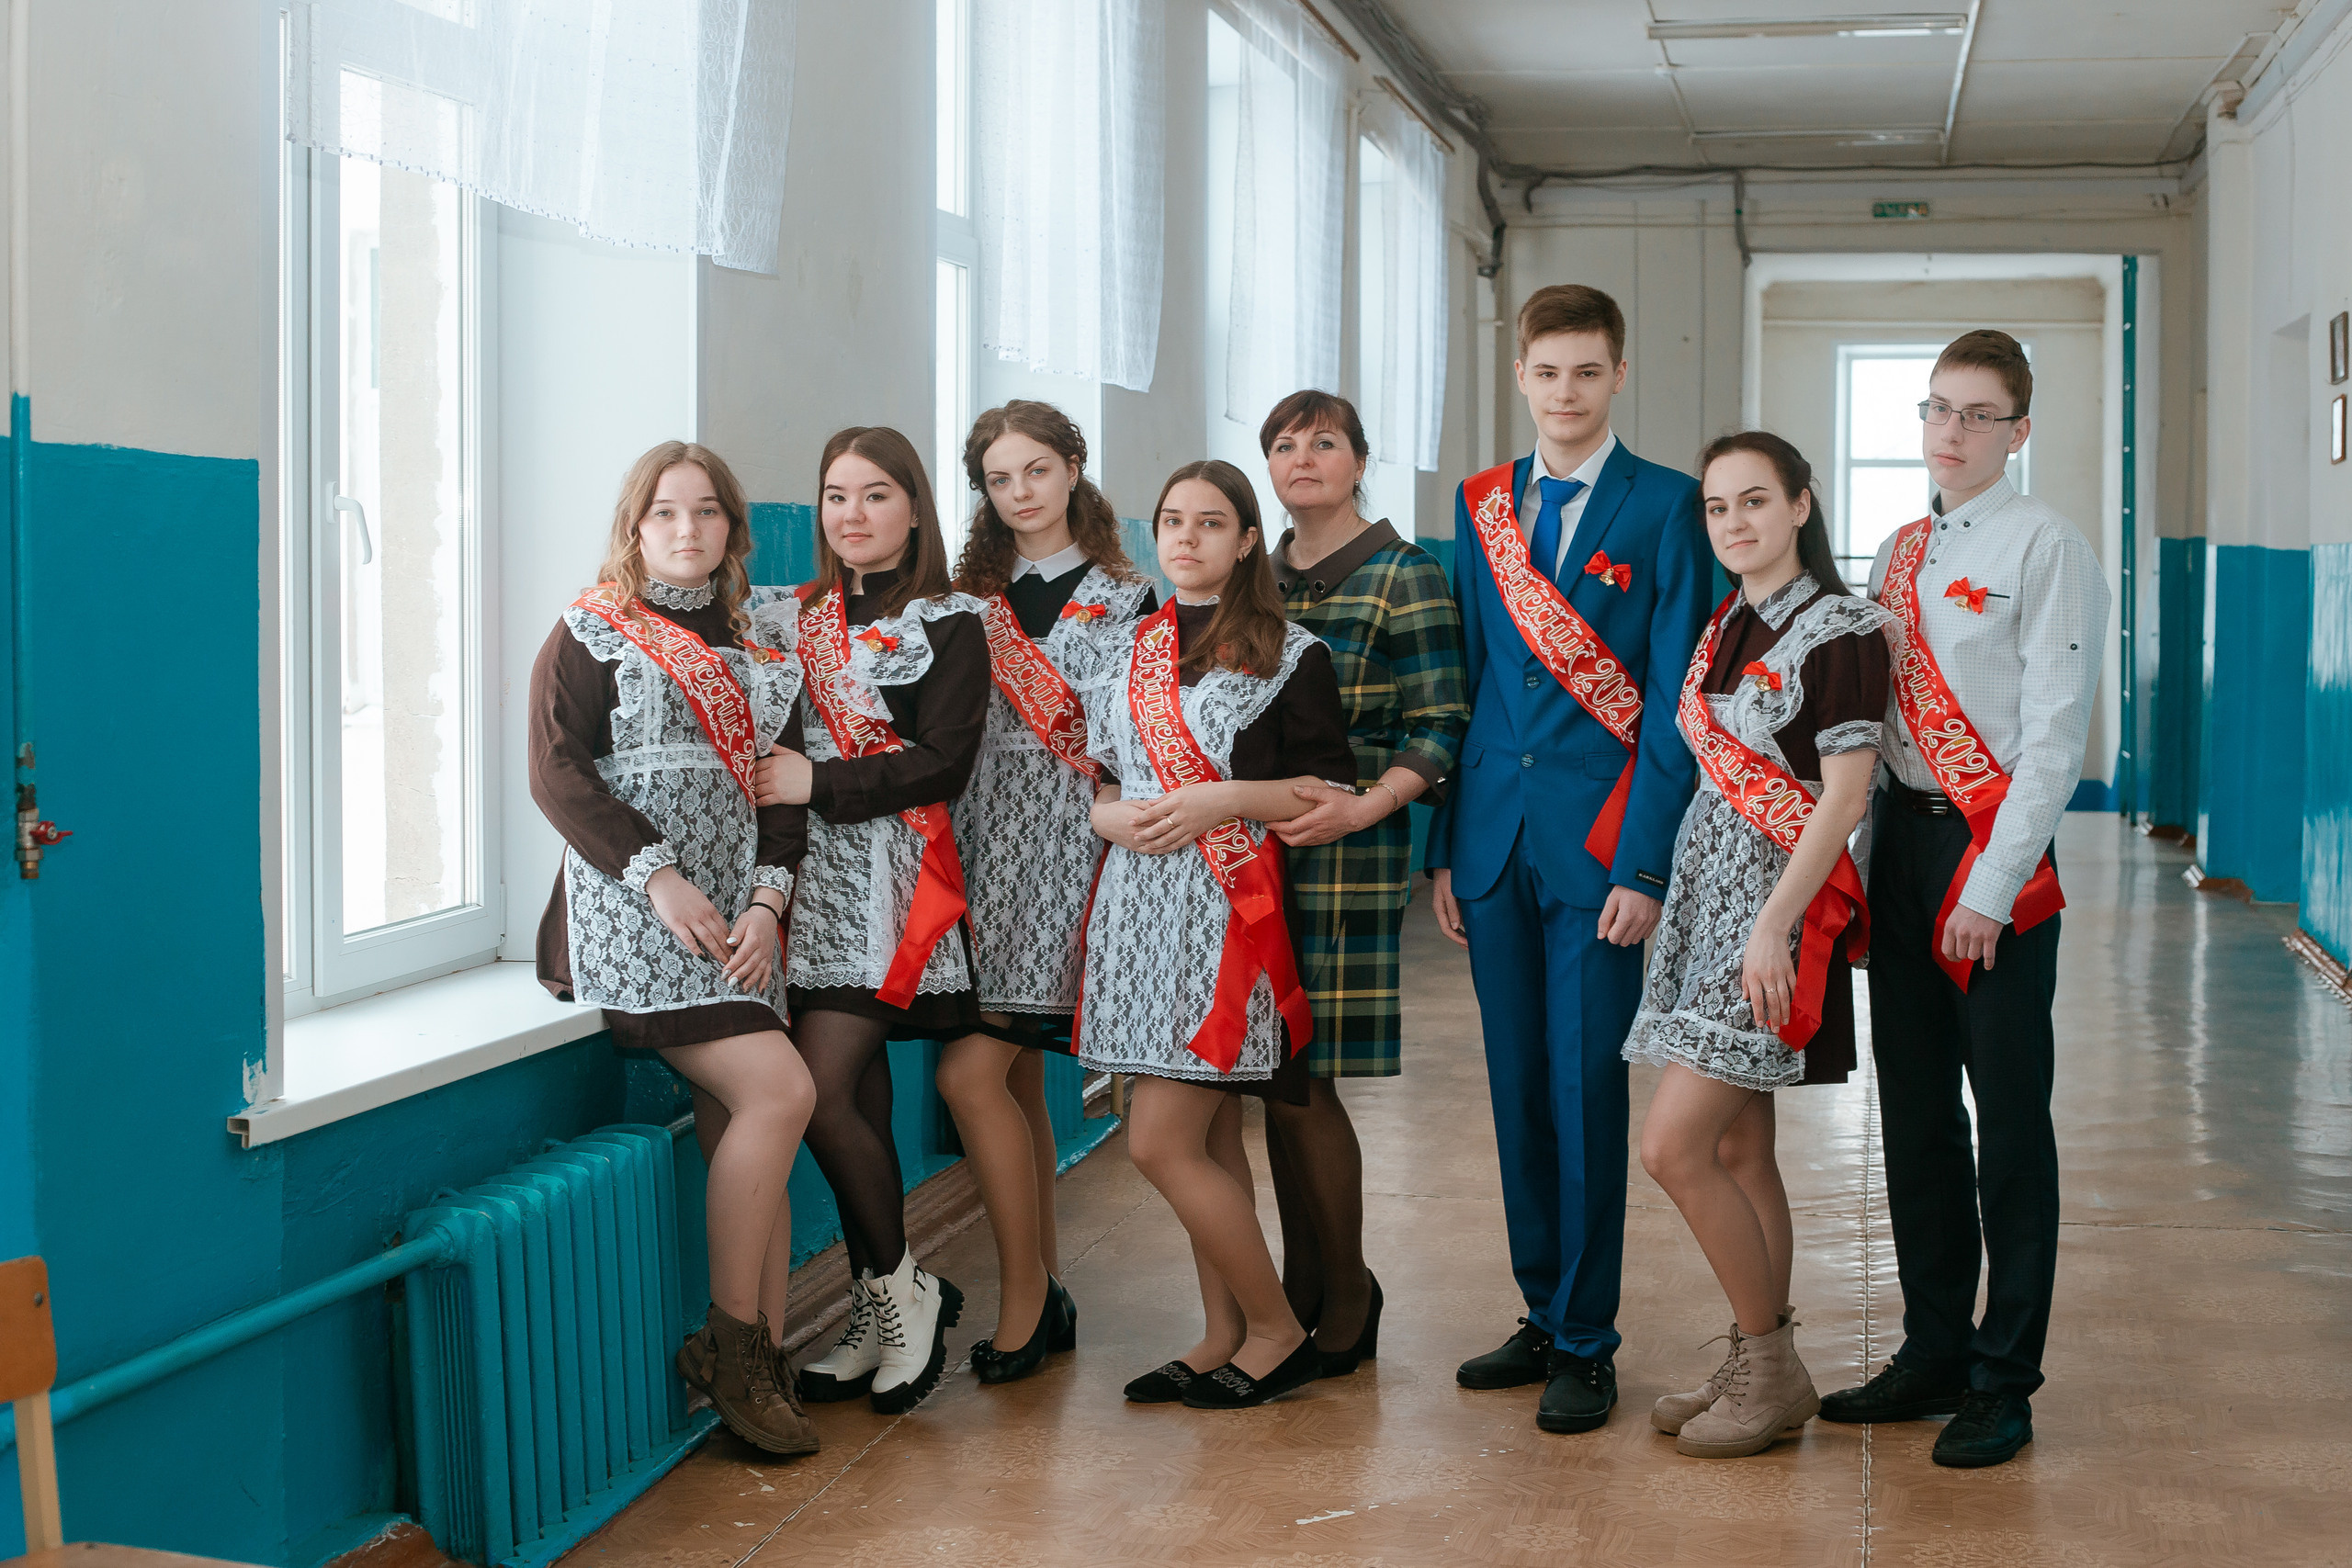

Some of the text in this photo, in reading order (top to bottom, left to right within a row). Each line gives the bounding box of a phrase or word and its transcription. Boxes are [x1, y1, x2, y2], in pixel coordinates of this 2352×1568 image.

[1485, 518, 1645, 731] Выпускник 2021
[1136, 649, 1259, 874] Выпускни 021
[1747, 778, 1815, 840] 202
[1922, 719, 1999, 796] 2021
